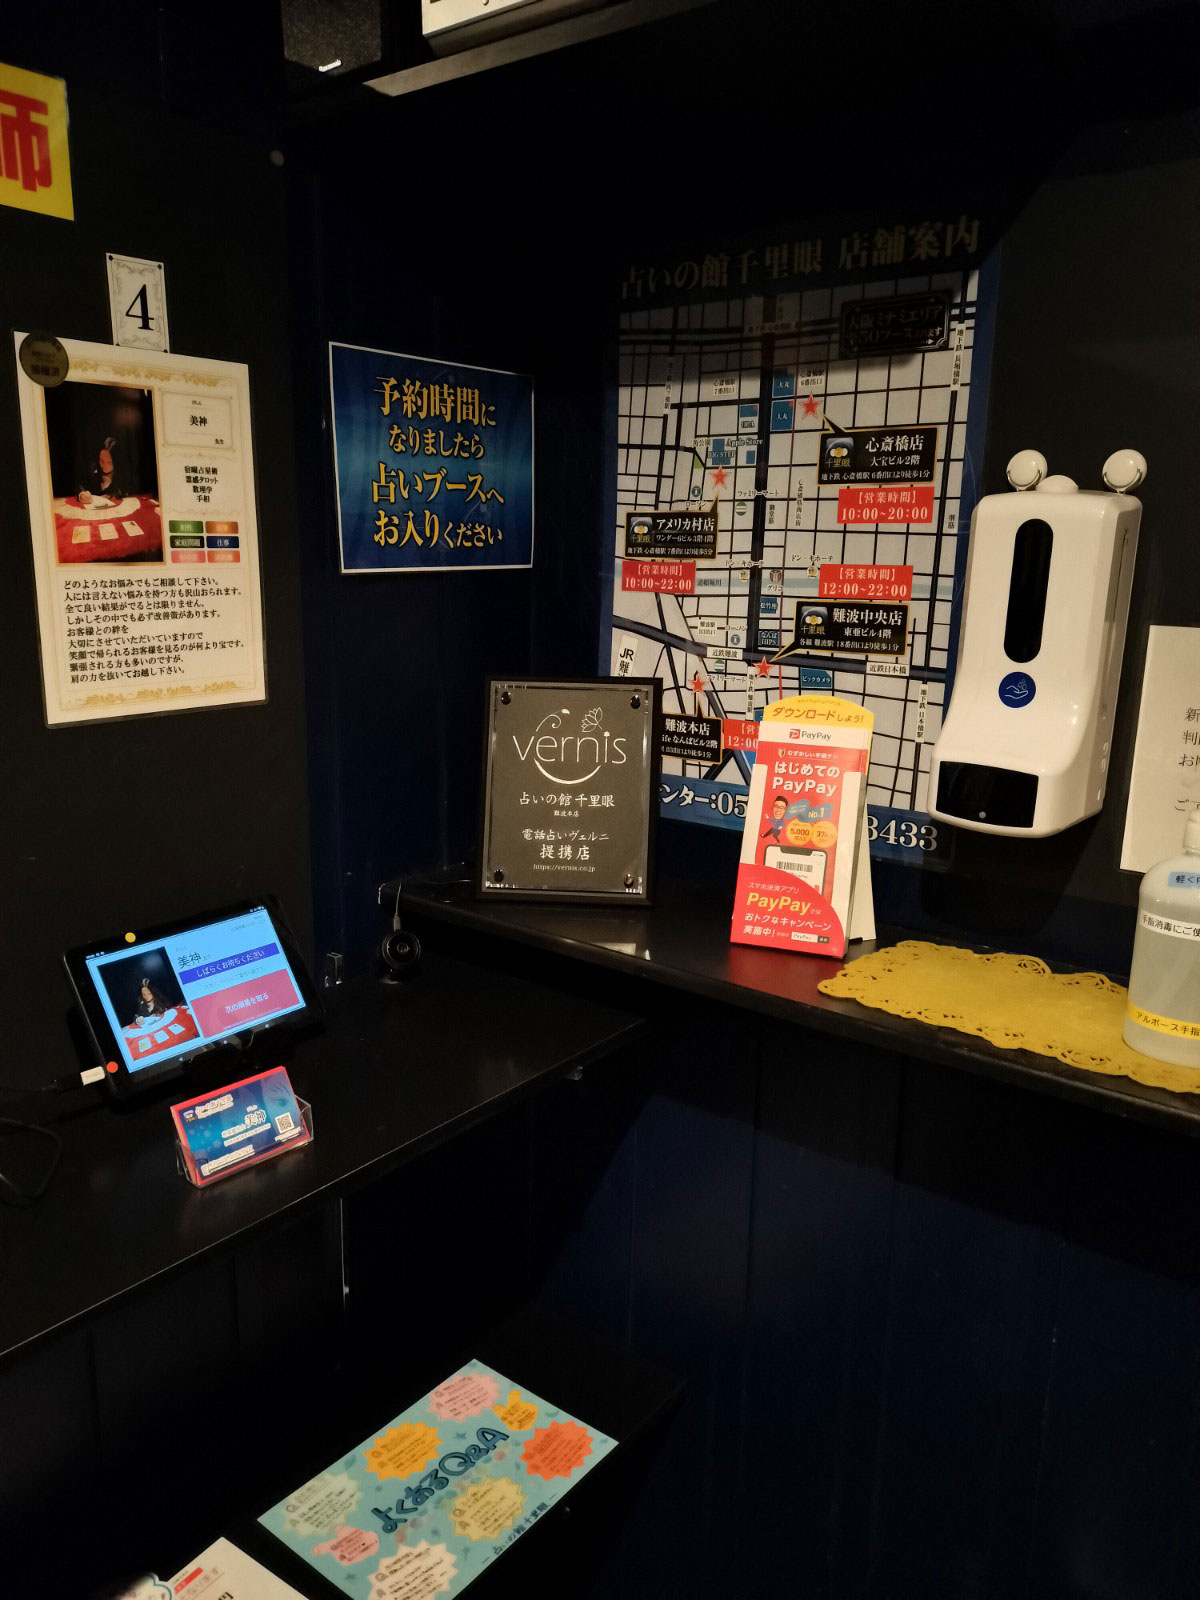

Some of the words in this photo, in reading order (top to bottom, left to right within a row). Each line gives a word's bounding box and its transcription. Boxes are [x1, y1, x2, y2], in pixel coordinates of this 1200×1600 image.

[838, 214, 981, 270] 店舗案内
[125, 283, 155, 331] 4
[373, 376, 497, 428] 予約時間に
[190, 415, 208, 427] 美神
[388, 424, 485, 459] なりましたら
[746, 437, 764, 446] Store
[865, 434, 925, 453] 心斎橋店
[870, 454, 921, 467] 大宝ビル2階
[184, 465, 218, 475] 宿曜占星術
[192, 485, 213, 494] 数理学
[372, 462, 505, 504] 占いブースへ
[196, 495, 210, 503] 手相
[858, 490, 917, 505] 【営業時間】
[373, 509, 504, 549] お入りください
[656, 517, 715, 532] アメリカ村店
[637, 563, 684, 576] 【営業時間】
[839, 567, 896, 582] 【営業時間】
[832, 608, 904, 626] 難波中央店
[844, 627, 893, 639] 東亜ビル4階
[712, 649, 738, 659] 近鉄難波
[868, 663, 907, 675] 近鉄日本橋
[801, 674, 832, 684] ビックカメラ
[664, 718, 711, 737] 難波本店
[801, 729, 832, 741] PayPay
[1181, 730, 1200, 746] 判
[512, 730, 627, 765] vernis
[774, 761, 841, 778] はじめての
[772, 776, 838, 797] PayPay
[808, 807, 825, 819] No.1
[522, 828, 610, 842] 電話占いヴェルニ
[539, 843, 591, 861] 提携店
[747, 881, 800, 895] スマホ決済アプリ
[746, 891, 812, 916] PayPay
[744, 912, 832, 931] おトクなキャンペーン
[793, 933, 812, 941] PayPay
[177, 951, 202, 969] 美神
[196, 950, 265, 978] しばらくお待ちください
